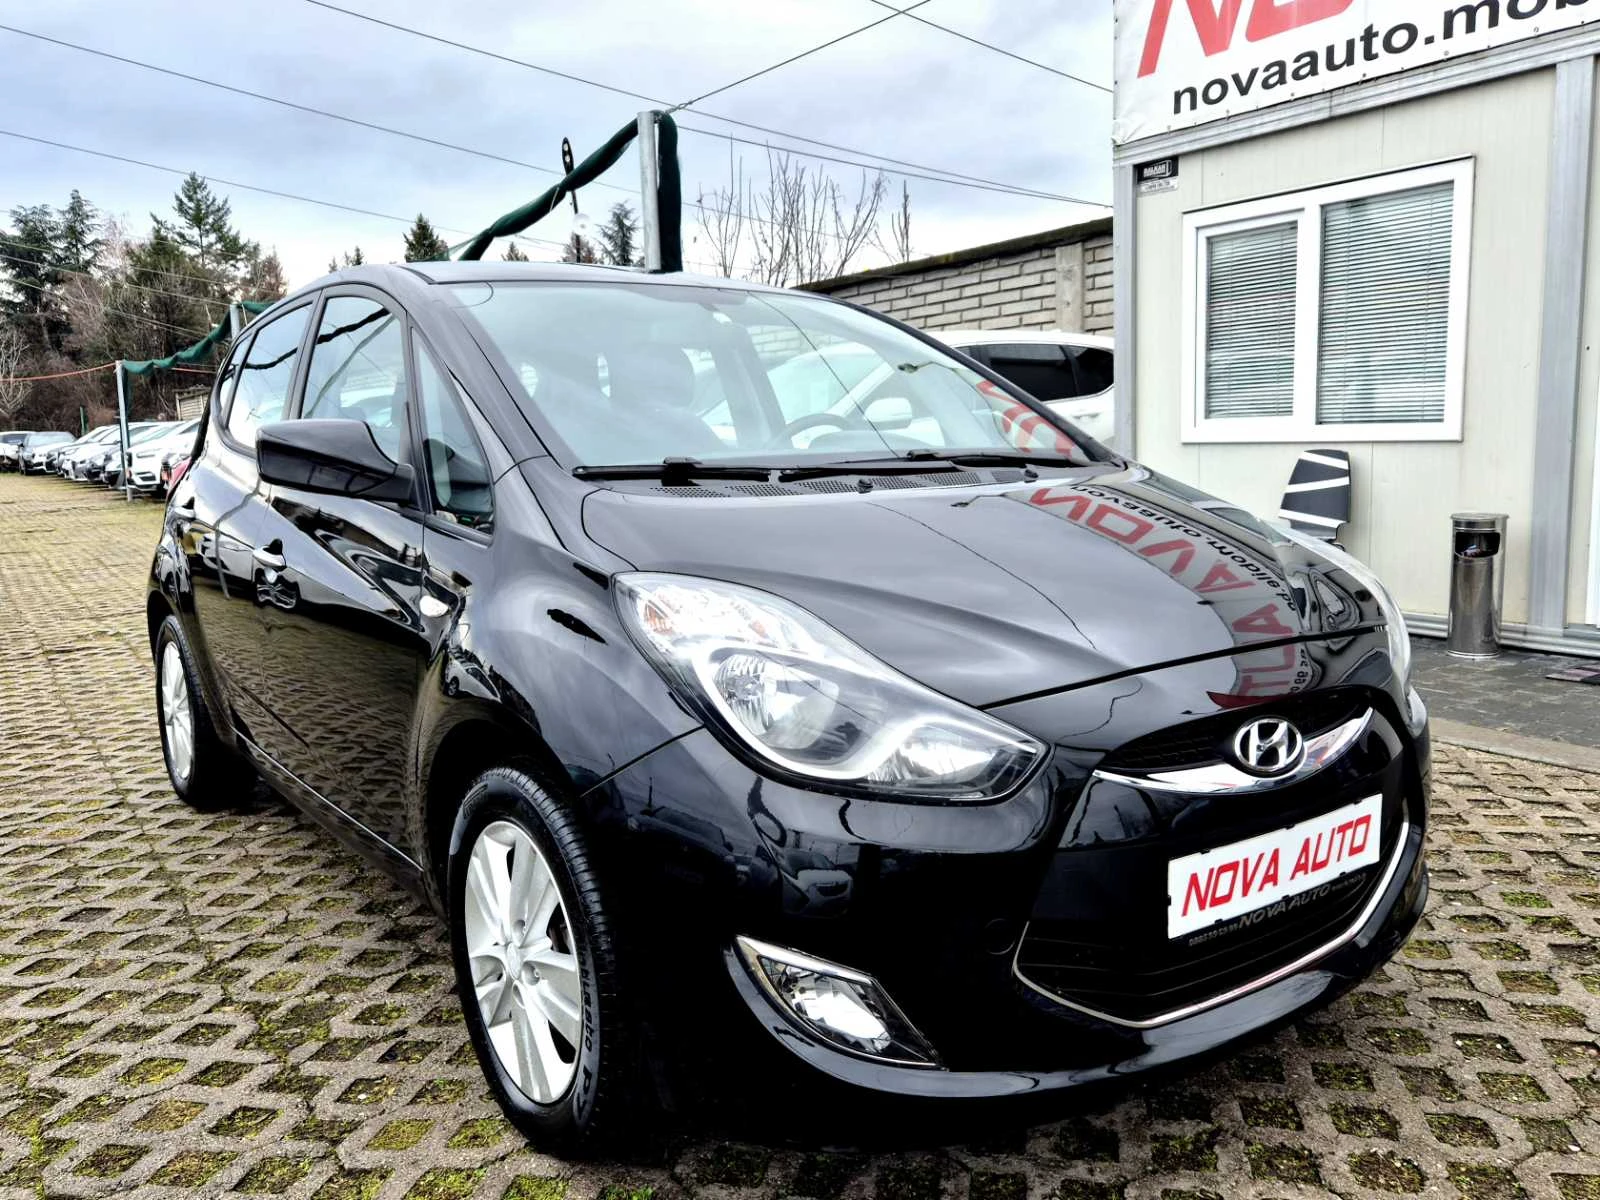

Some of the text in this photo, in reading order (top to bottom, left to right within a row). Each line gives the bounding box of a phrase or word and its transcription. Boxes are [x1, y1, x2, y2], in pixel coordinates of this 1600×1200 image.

[1181, 814, 1372, 917] NOVA AUTO
[1239, 883, 1330, 929] NOVA AUTO
